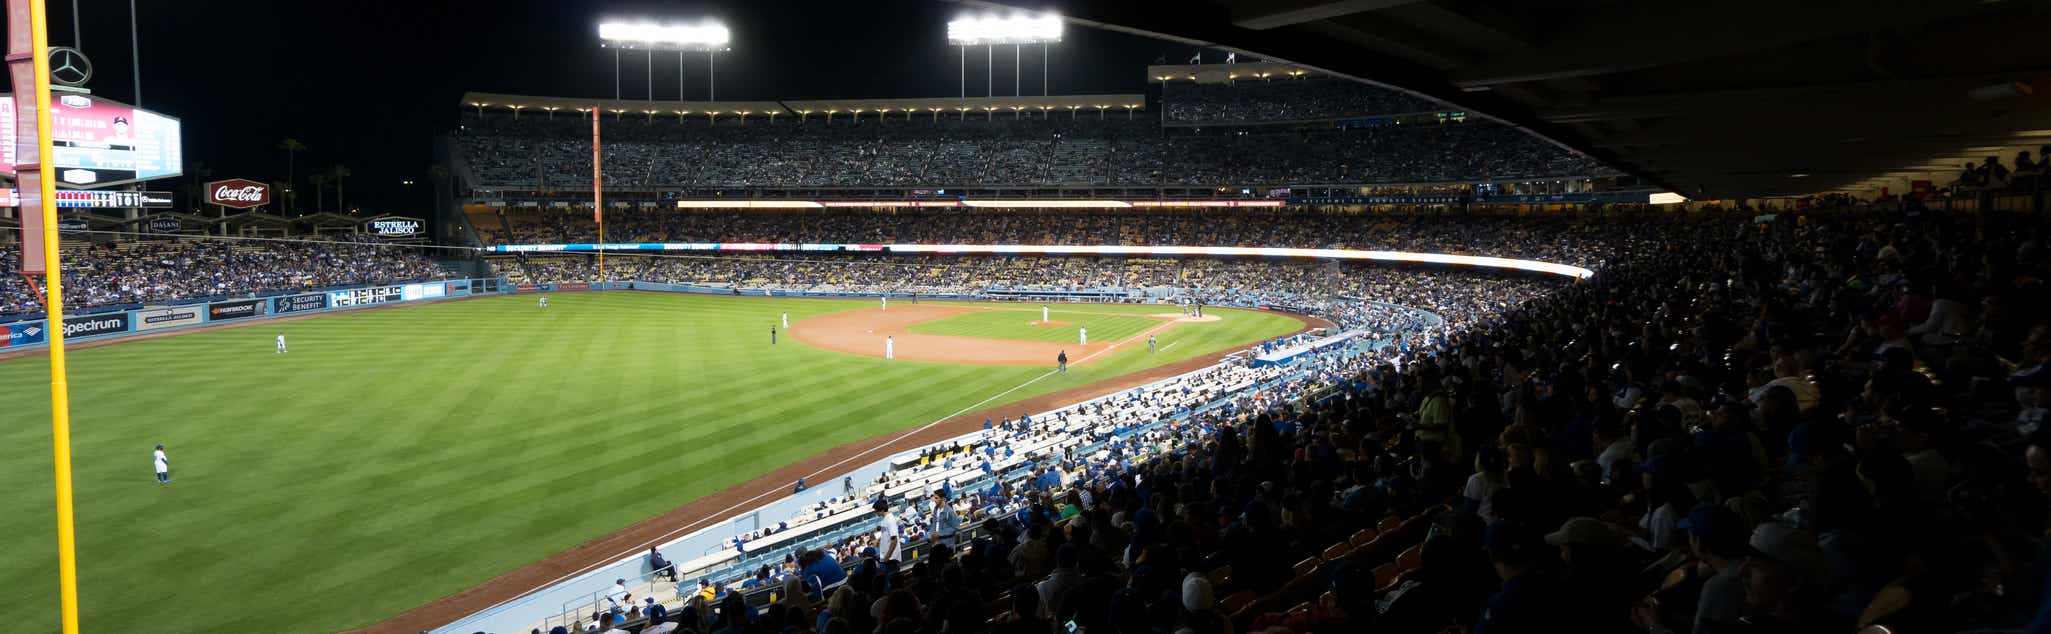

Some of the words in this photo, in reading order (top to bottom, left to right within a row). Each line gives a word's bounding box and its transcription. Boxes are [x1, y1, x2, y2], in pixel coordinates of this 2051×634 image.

[215, 185, 264, 201] Coca-Cola
[374, 221, 419, 229] ESTRELLA
[292, 294, 323, 303] SECURITY
[292, 302, 321, 311] BENEFIT
[63, 318, 120, 335] Spectrum
